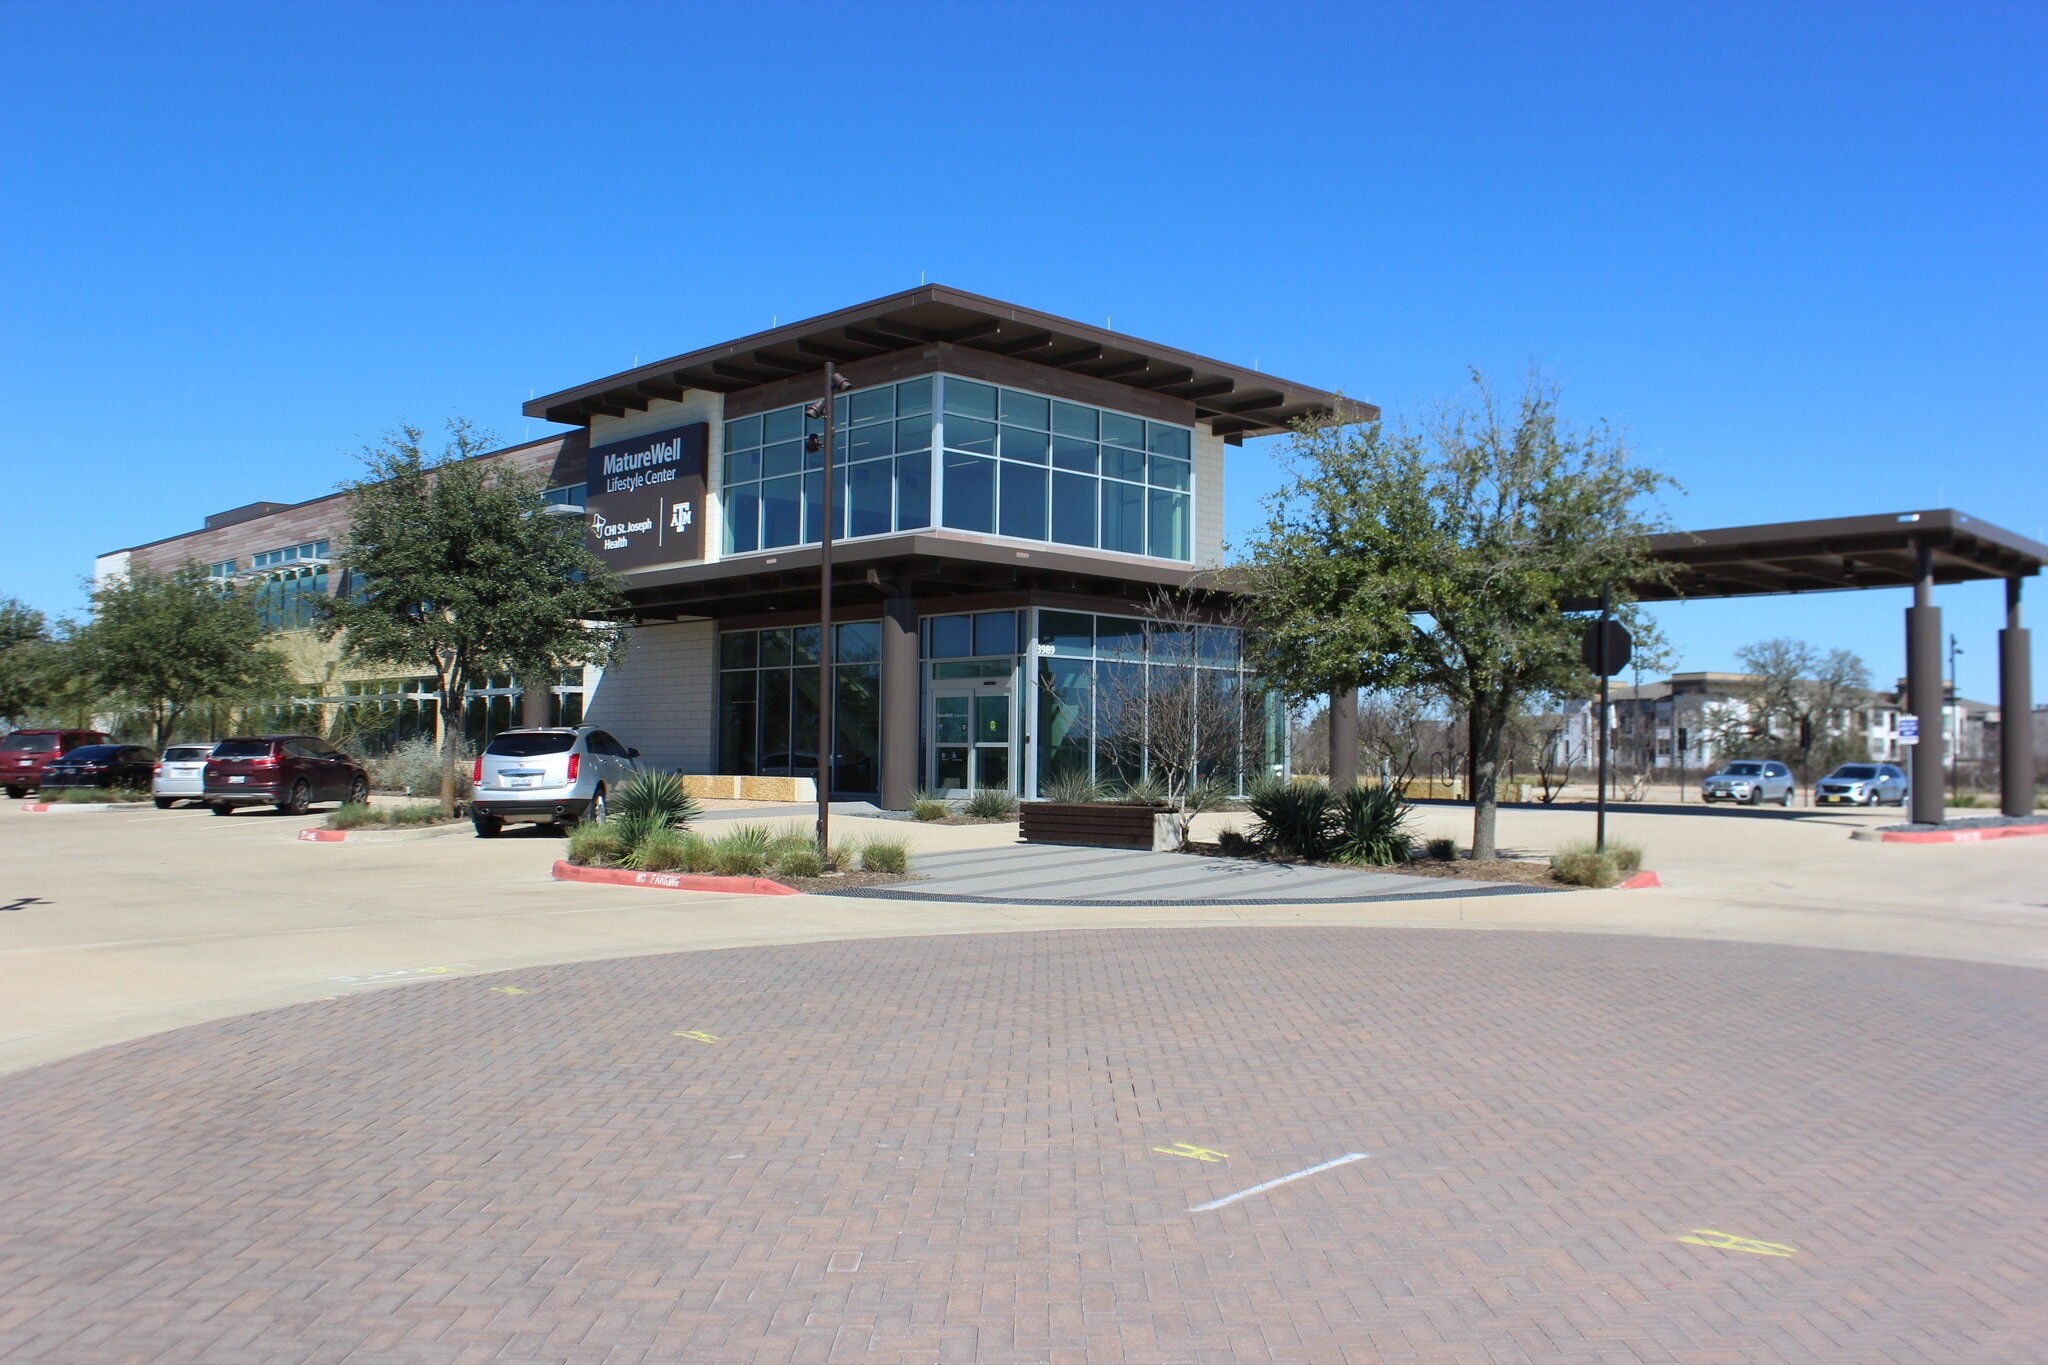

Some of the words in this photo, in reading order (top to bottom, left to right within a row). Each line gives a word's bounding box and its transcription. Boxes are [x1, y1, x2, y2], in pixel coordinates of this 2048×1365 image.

[602, 437, 682, 476] MatureWell
[606, 472, 644, 493] Lifestyle
[645, 468, 677, 485] Center
[604, 524, 617, 537] CHI
[617, 523, 627, 535] St.
[627, 517, 653, 534] Joseph
[604, 535, 628, 550] Health
[1037, 644, 1056, 655] 3989
[635, 872, 647, 883] NO
[649, 873, 681, 887] PARKING
